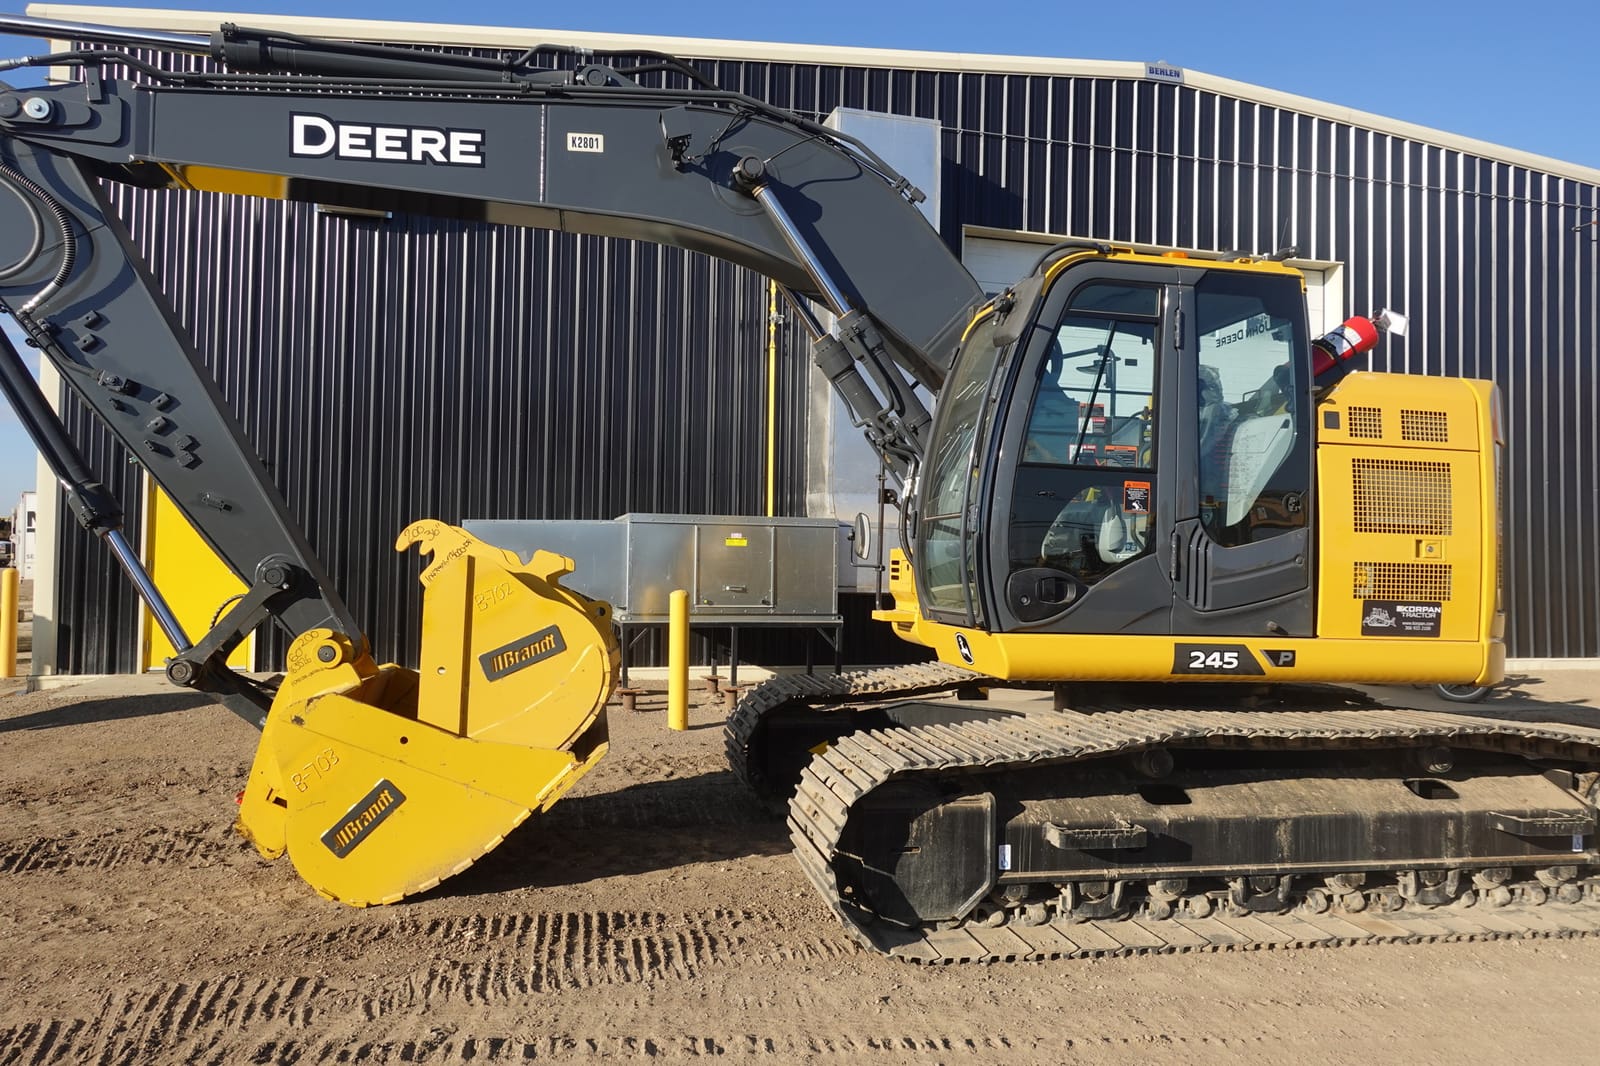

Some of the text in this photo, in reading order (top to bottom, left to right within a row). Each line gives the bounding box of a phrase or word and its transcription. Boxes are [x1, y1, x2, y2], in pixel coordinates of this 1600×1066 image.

[1148, 66, 1181, 78] BEHLEN
[292, 114, 482, 165] DEERE
[571, 136, 600, 149] K2801
[499, 633, 557, 670] Brandt
[1188, 650, 1294, 669] 245 P
[340, 788, 395, 843] Brandt
